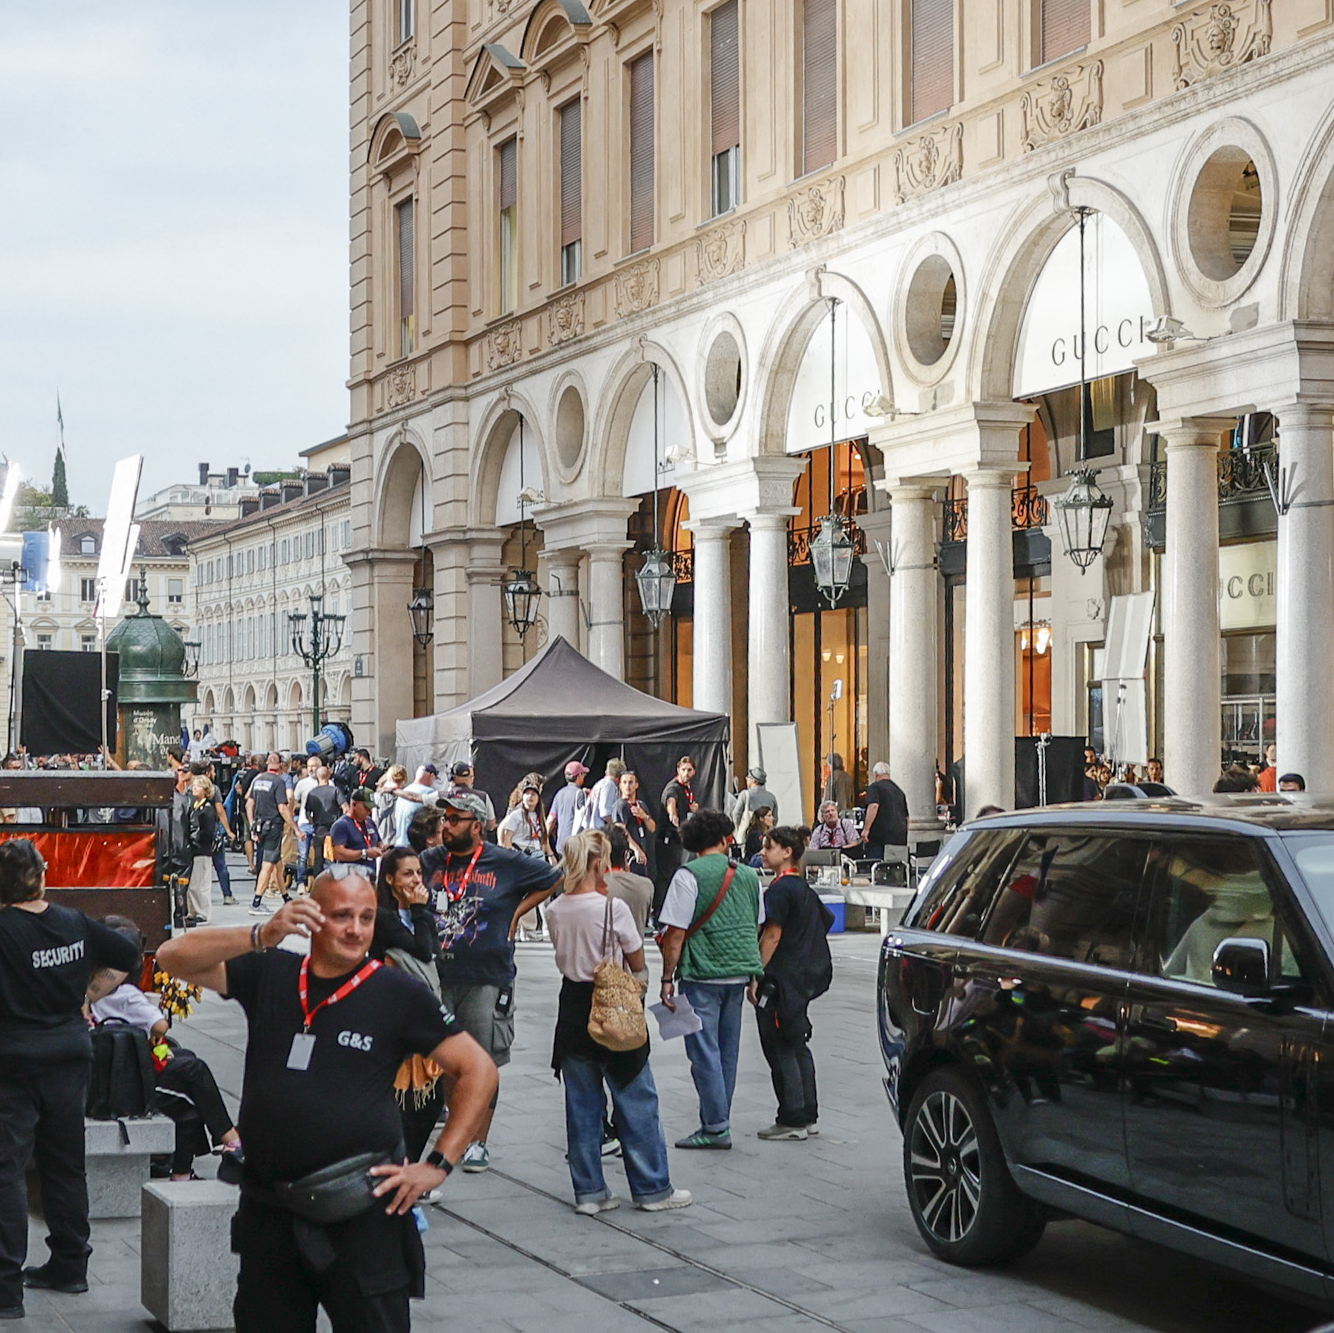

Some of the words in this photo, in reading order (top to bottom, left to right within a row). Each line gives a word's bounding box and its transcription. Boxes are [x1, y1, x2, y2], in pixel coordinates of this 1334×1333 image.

[1051, 315, 1144, 366] GUCCI
[32, 939, 84, 968] SECURITY
[337, 1030, 373, 1051] G&S
